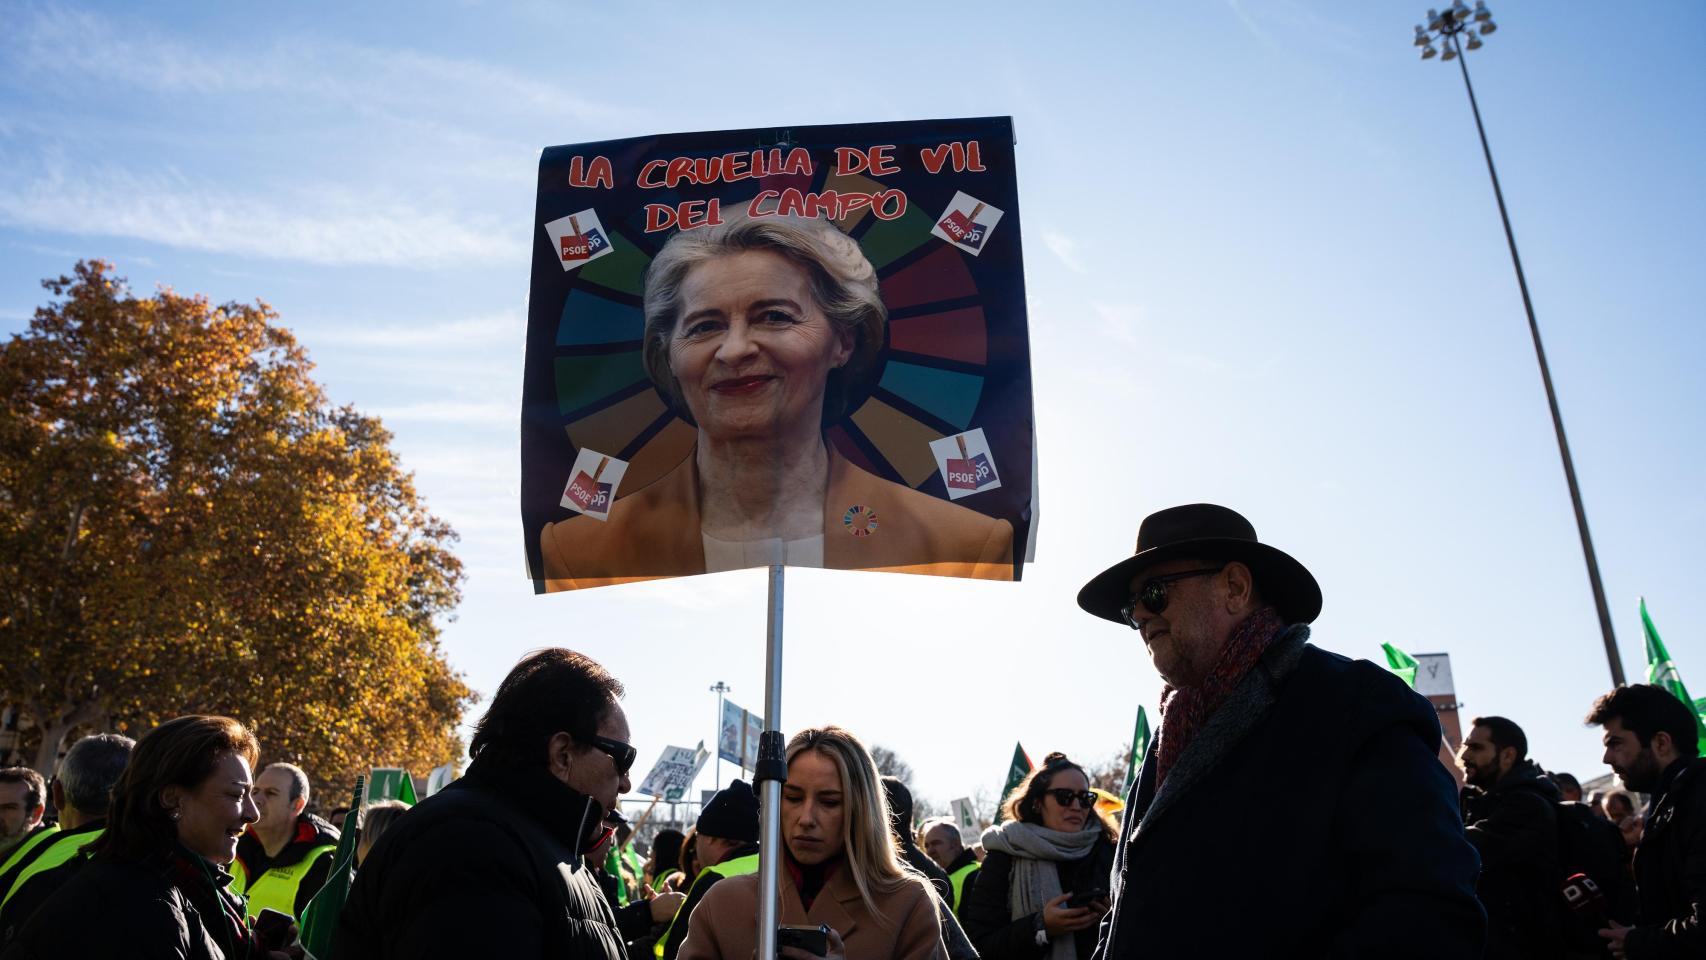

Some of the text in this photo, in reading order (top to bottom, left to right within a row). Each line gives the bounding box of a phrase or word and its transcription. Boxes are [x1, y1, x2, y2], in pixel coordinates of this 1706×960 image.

[569, 141, 986, 189] LA CRUELLA DE VIL
[644, 189, 907, 233] DEL CAMPO
[943, 218, 965, 237] PSOE
[562, 245, 588, 256] PSOE
[949, 472, 975, 484] PSOE
[570, 482, 592, 504] PSOE
